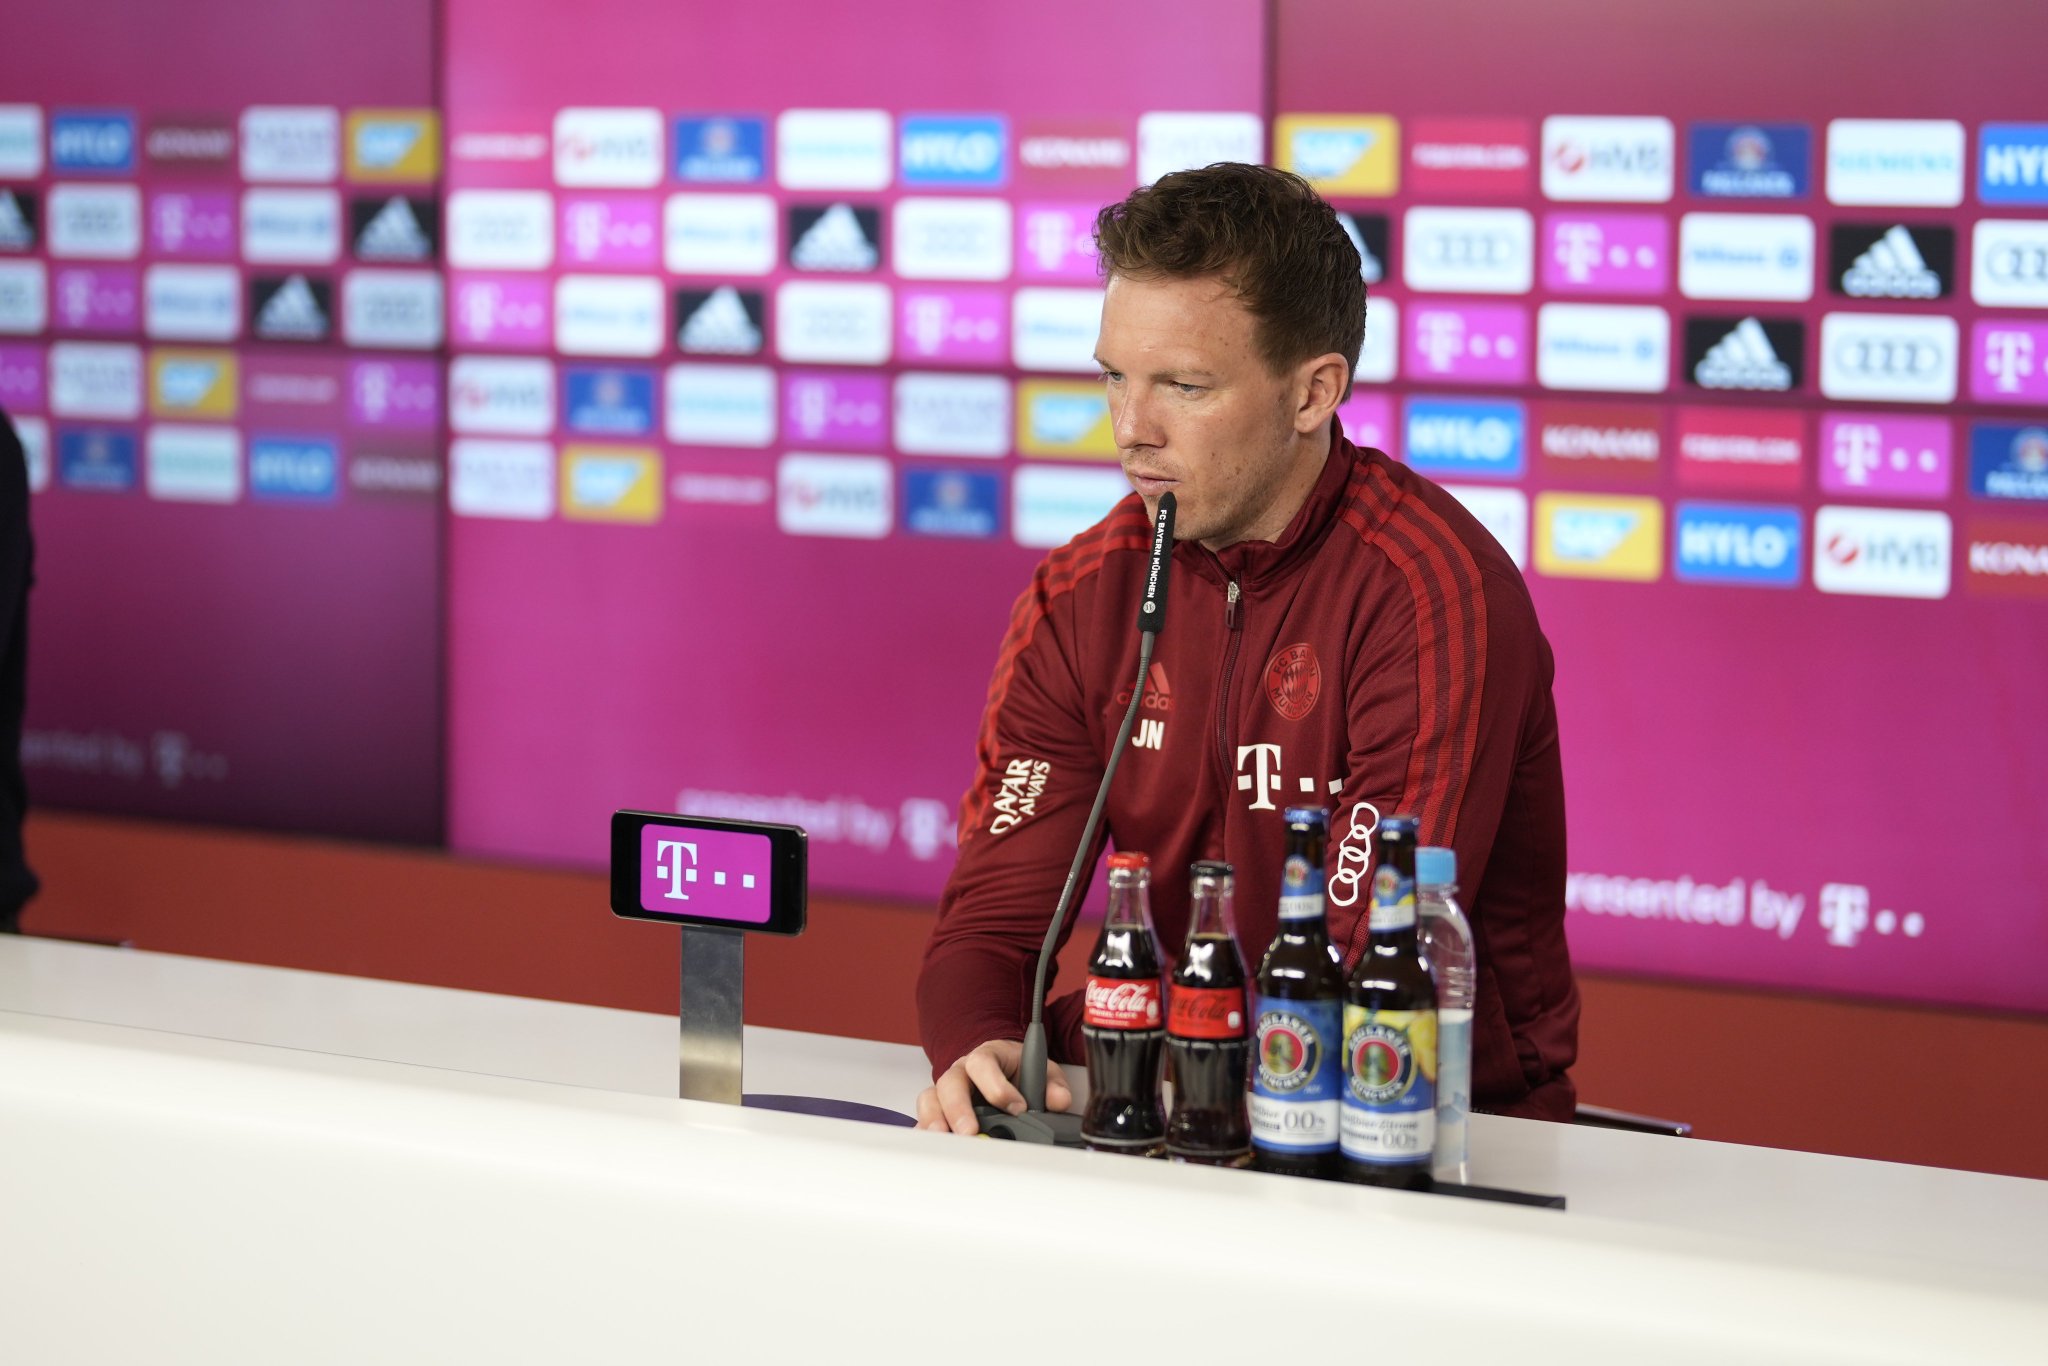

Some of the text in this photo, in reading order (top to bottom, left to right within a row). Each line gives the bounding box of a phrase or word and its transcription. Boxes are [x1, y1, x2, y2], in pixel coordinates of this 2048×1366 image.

[1147, 509, 1167, 599] FC BAYERN MÜNCHEN
[1131, 718, 1165, 750] JN
[989, 759, 1034, 834] QATAR
